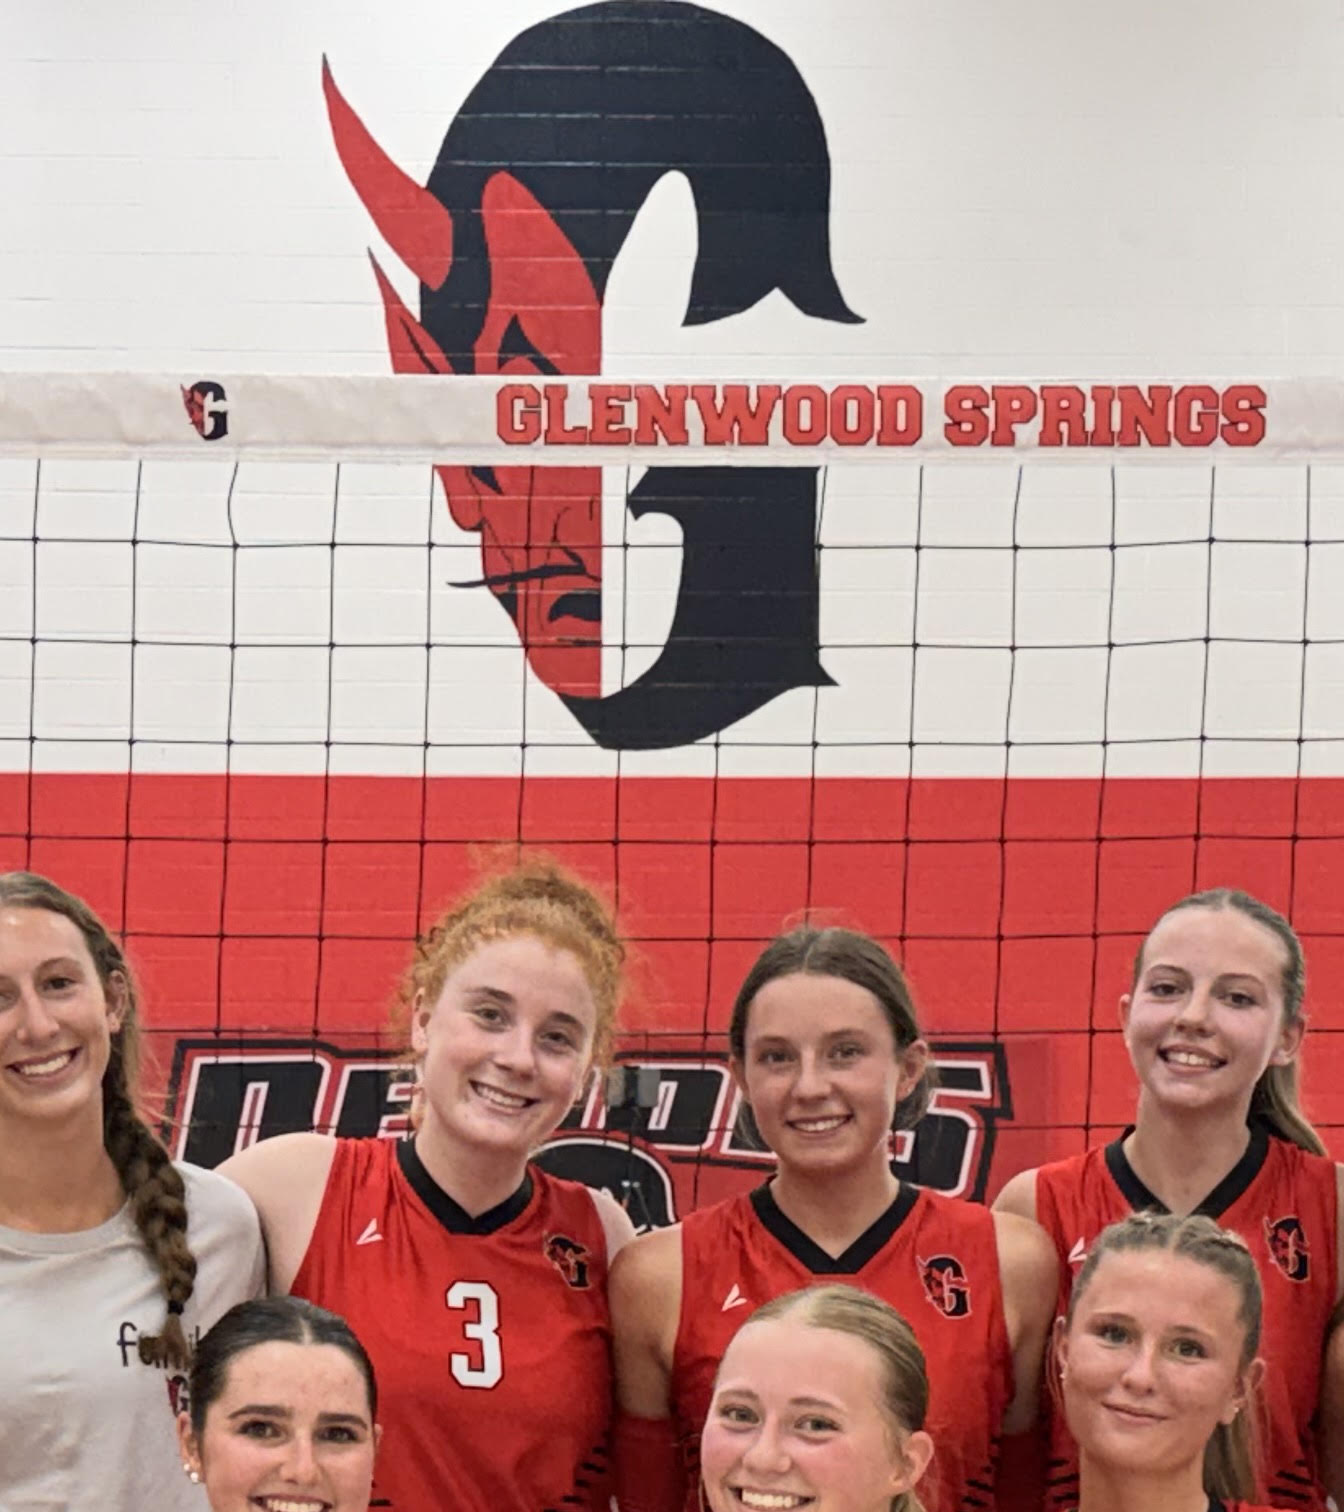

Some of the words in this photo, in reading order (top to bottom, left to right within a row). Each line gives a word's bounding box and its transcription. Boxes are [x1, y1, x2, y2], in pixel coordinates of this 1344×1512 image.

[496, 384, 924, 447] GLENWOOD
[943, 385, 1268, 447] SPRINGS
[444, 1279, 504, 1391] 3
